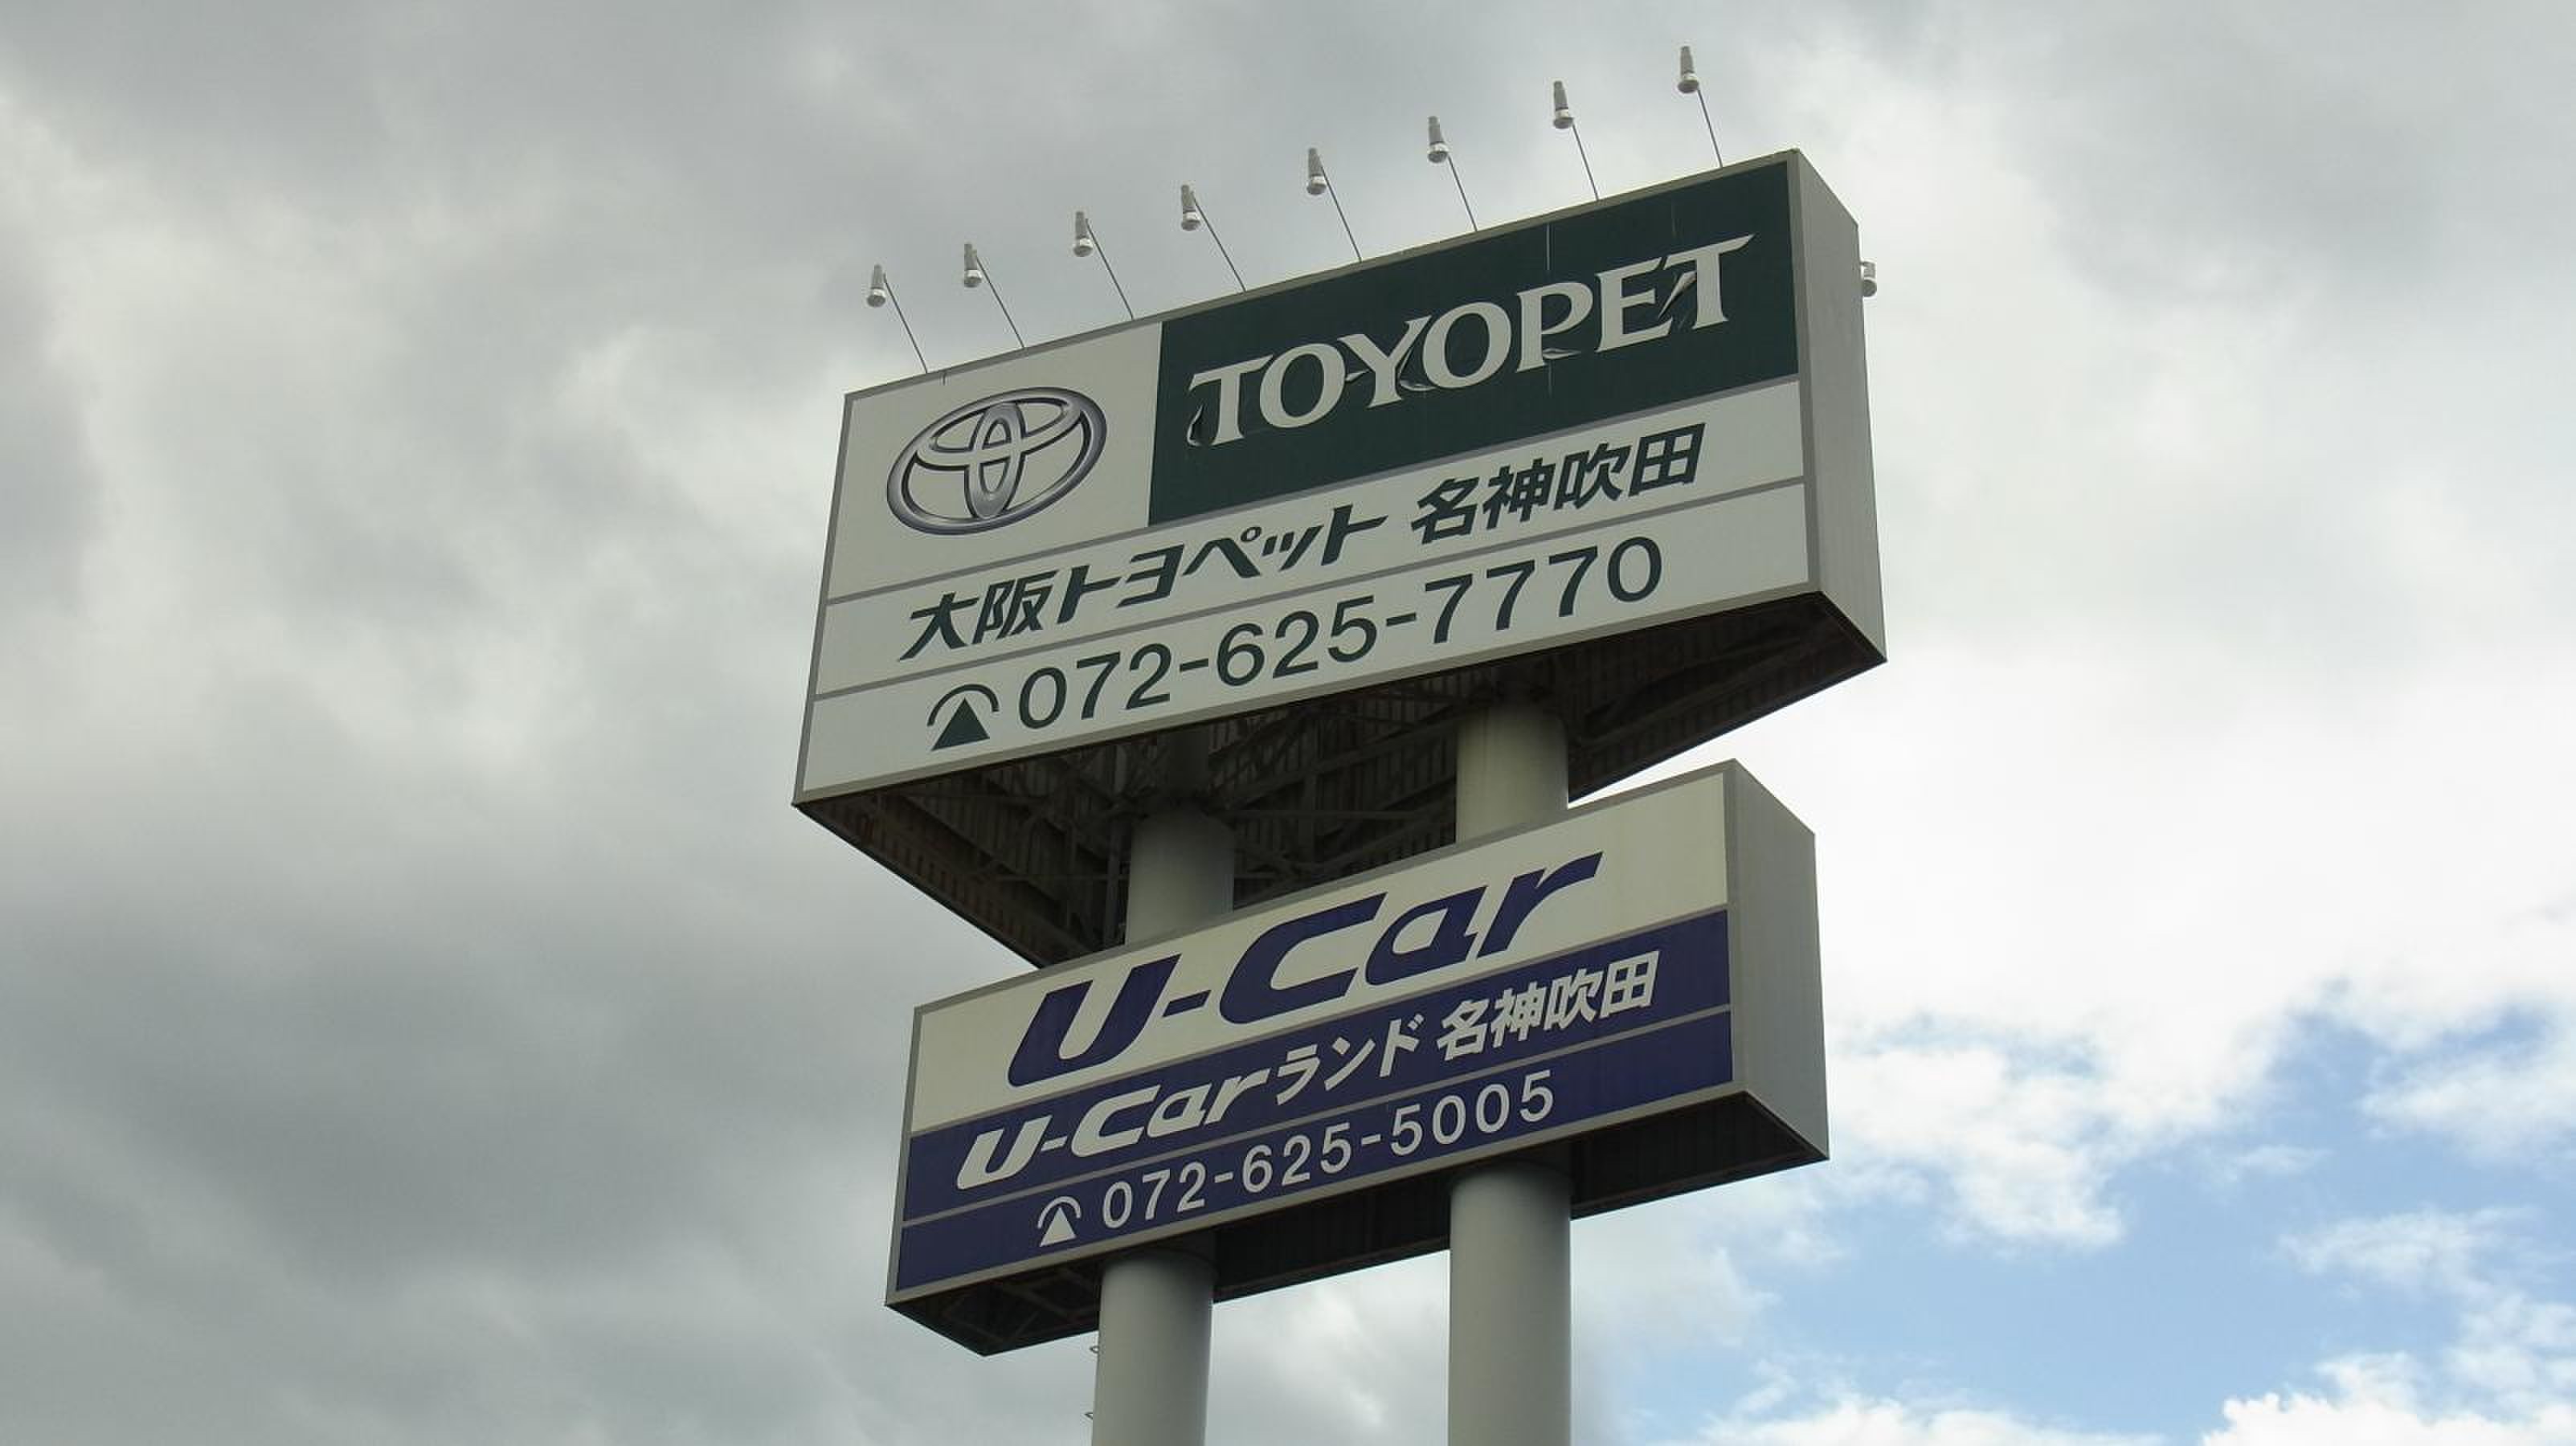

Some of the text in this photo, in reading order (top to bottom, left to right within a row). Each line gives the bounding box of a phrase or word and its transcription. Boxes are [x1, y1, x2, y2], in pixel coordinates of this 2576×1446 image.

[1186, 233, 1756, 447] TOYOPET
[898, 422, 1706, 662] 大阪トヨペット 名神吹田
[1017, 536, 1662, 729] 072-625-7770
[1007, 850, 1605, 1087] U-Car
[1437, 950, 1660, 1061] 名神吹田
[1102, 1069, 1555, 1230] 072-625-5005
